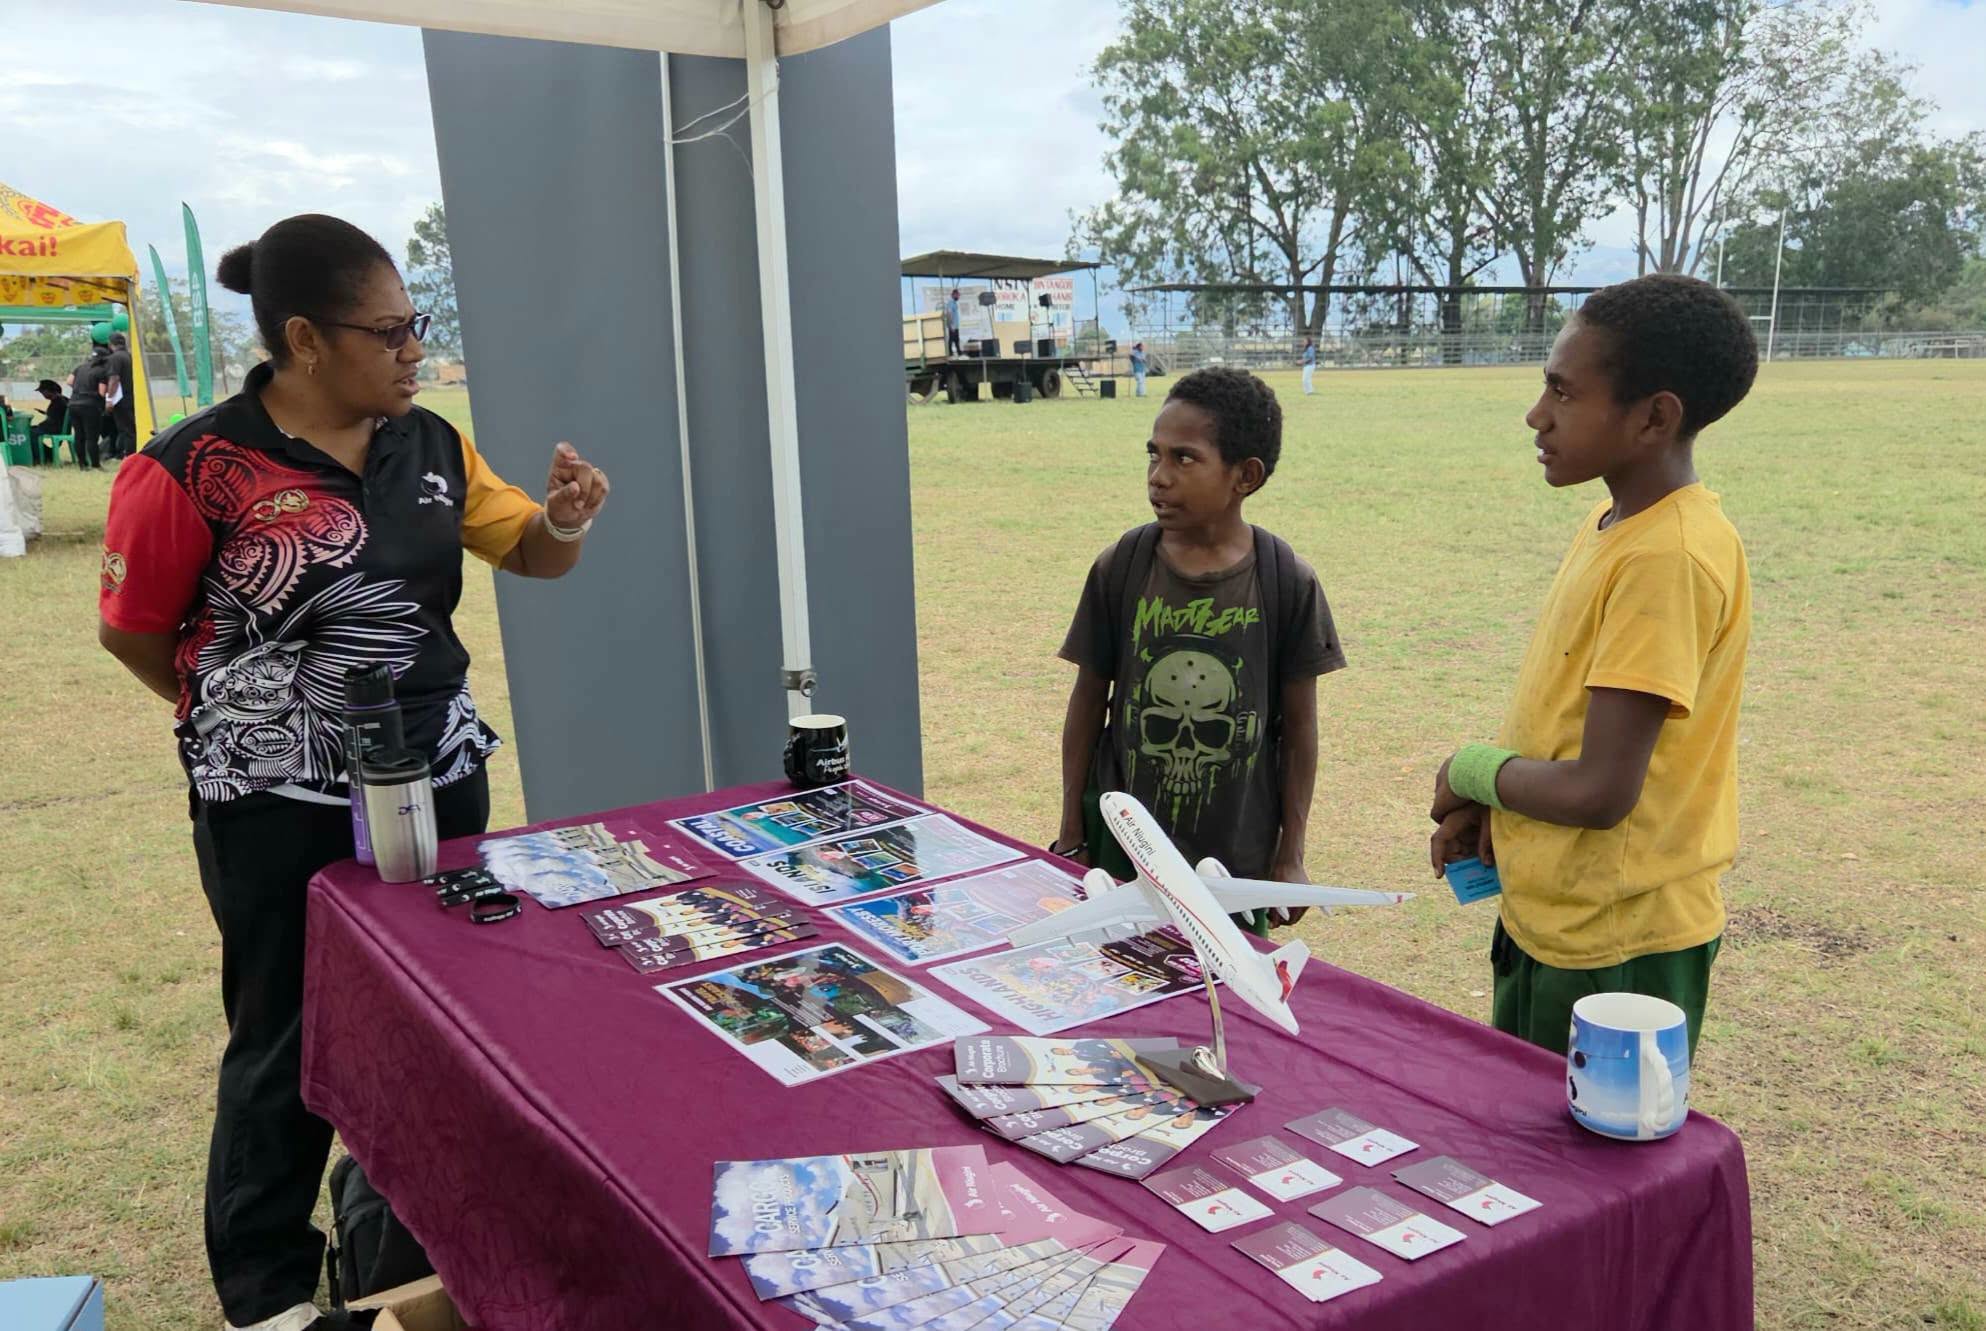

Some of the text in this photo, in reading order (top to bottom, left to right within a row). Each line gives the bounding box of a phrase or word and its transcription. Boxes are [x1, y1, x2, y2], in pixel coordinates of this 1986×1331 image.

[8, 433, 26, 446] SP
[690, 819, 755, 853] COASTAL
[1126, 816, 1157, 856] Air Niugini
[767, 860, 836, 895] ISLANDS
[960, 967, 1064, 1021] HIGHLANDS
[979, 1039, 995, 1078] Corporate
[752, 1180, 784, 1233] CARGO
